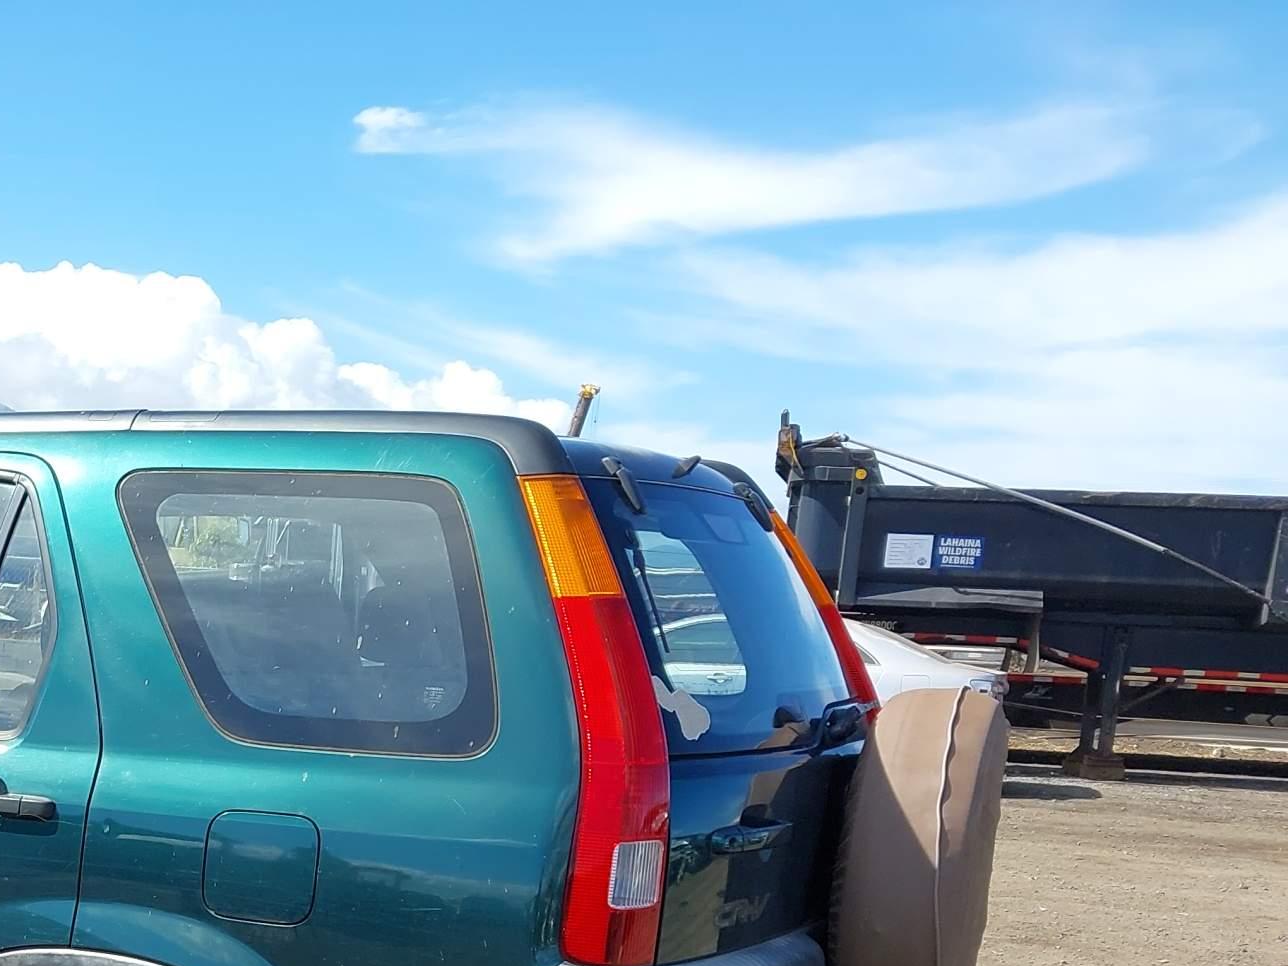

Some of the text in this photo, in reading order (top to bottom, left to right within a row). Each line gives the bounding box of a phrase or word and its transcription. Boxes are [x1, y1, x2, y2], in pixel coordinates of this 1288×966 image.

[940, 537, 982, 548] LAHAINA
[938, 547, 982, 557] WILDFIRE
[942, 556, 975, 565] DEBRIS
